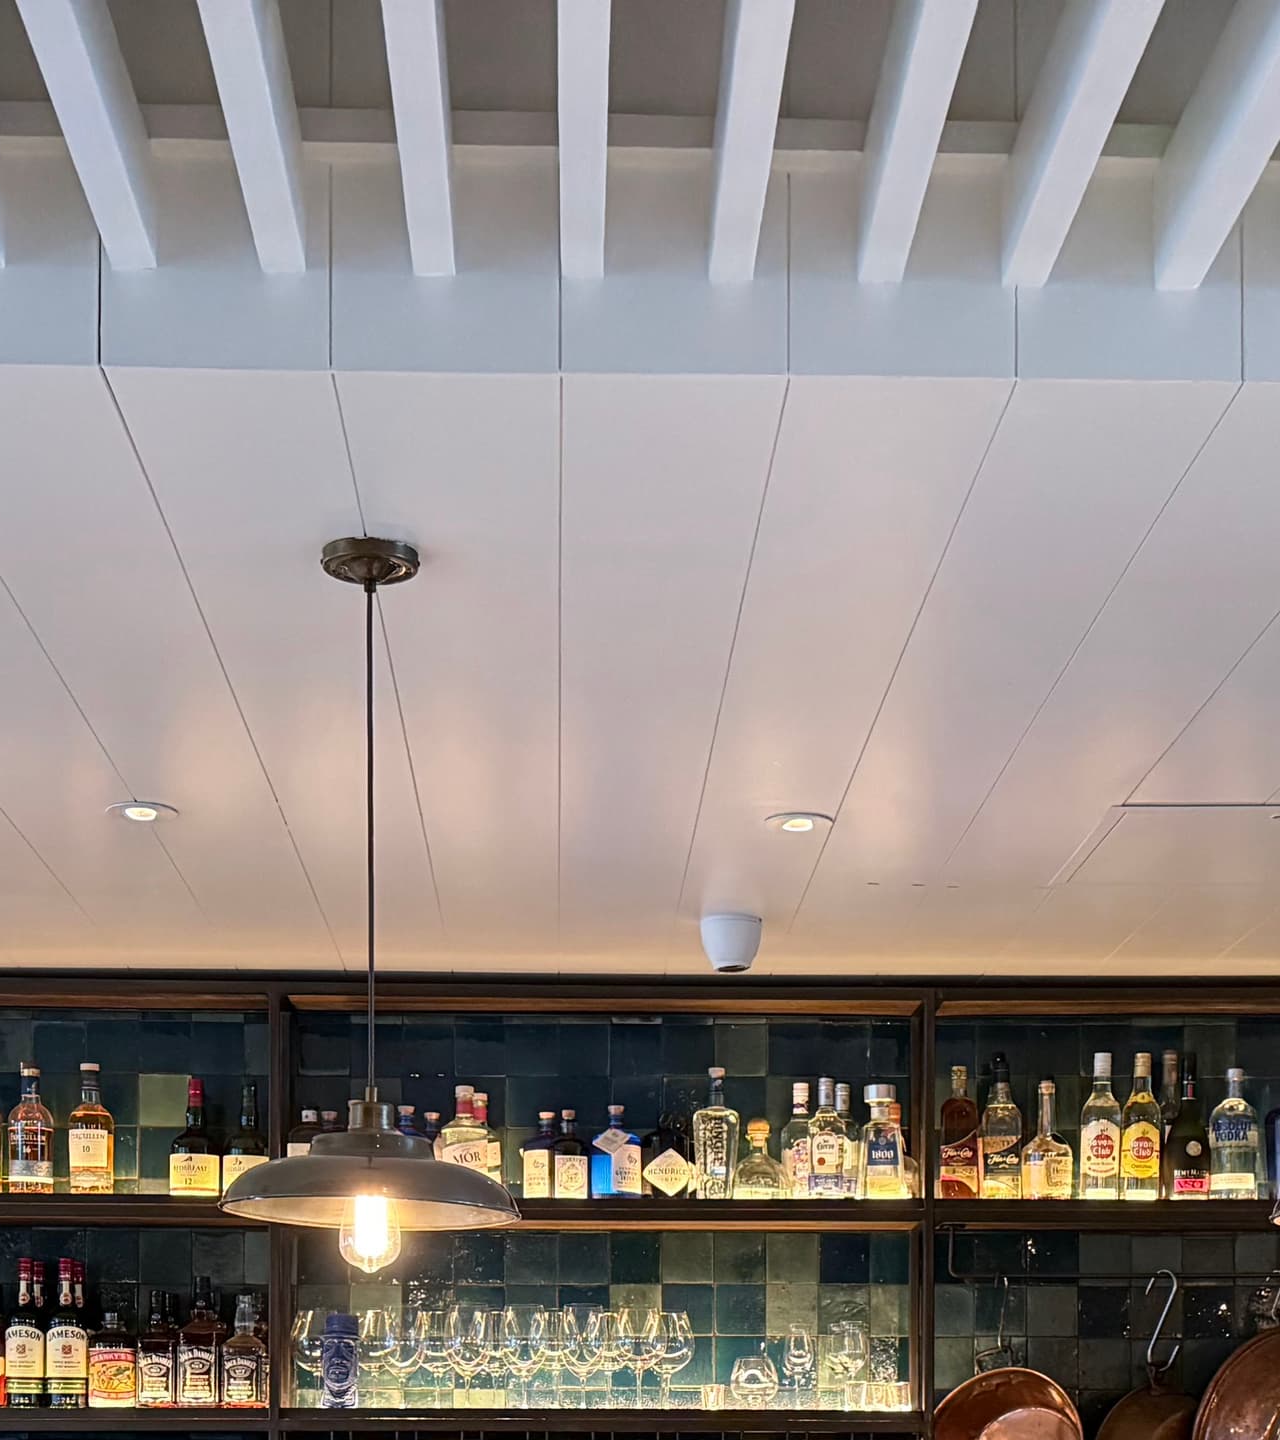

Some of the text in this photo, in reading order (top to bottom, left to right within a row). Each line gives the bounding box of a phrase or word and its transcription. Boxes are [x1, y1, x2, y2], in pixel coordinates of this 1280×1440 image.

[871, 1149, 894, 1159] 1800
[6, 1329, 41, 1342] JAMESON
[49, 1329, 86, 1342] JAMESON
